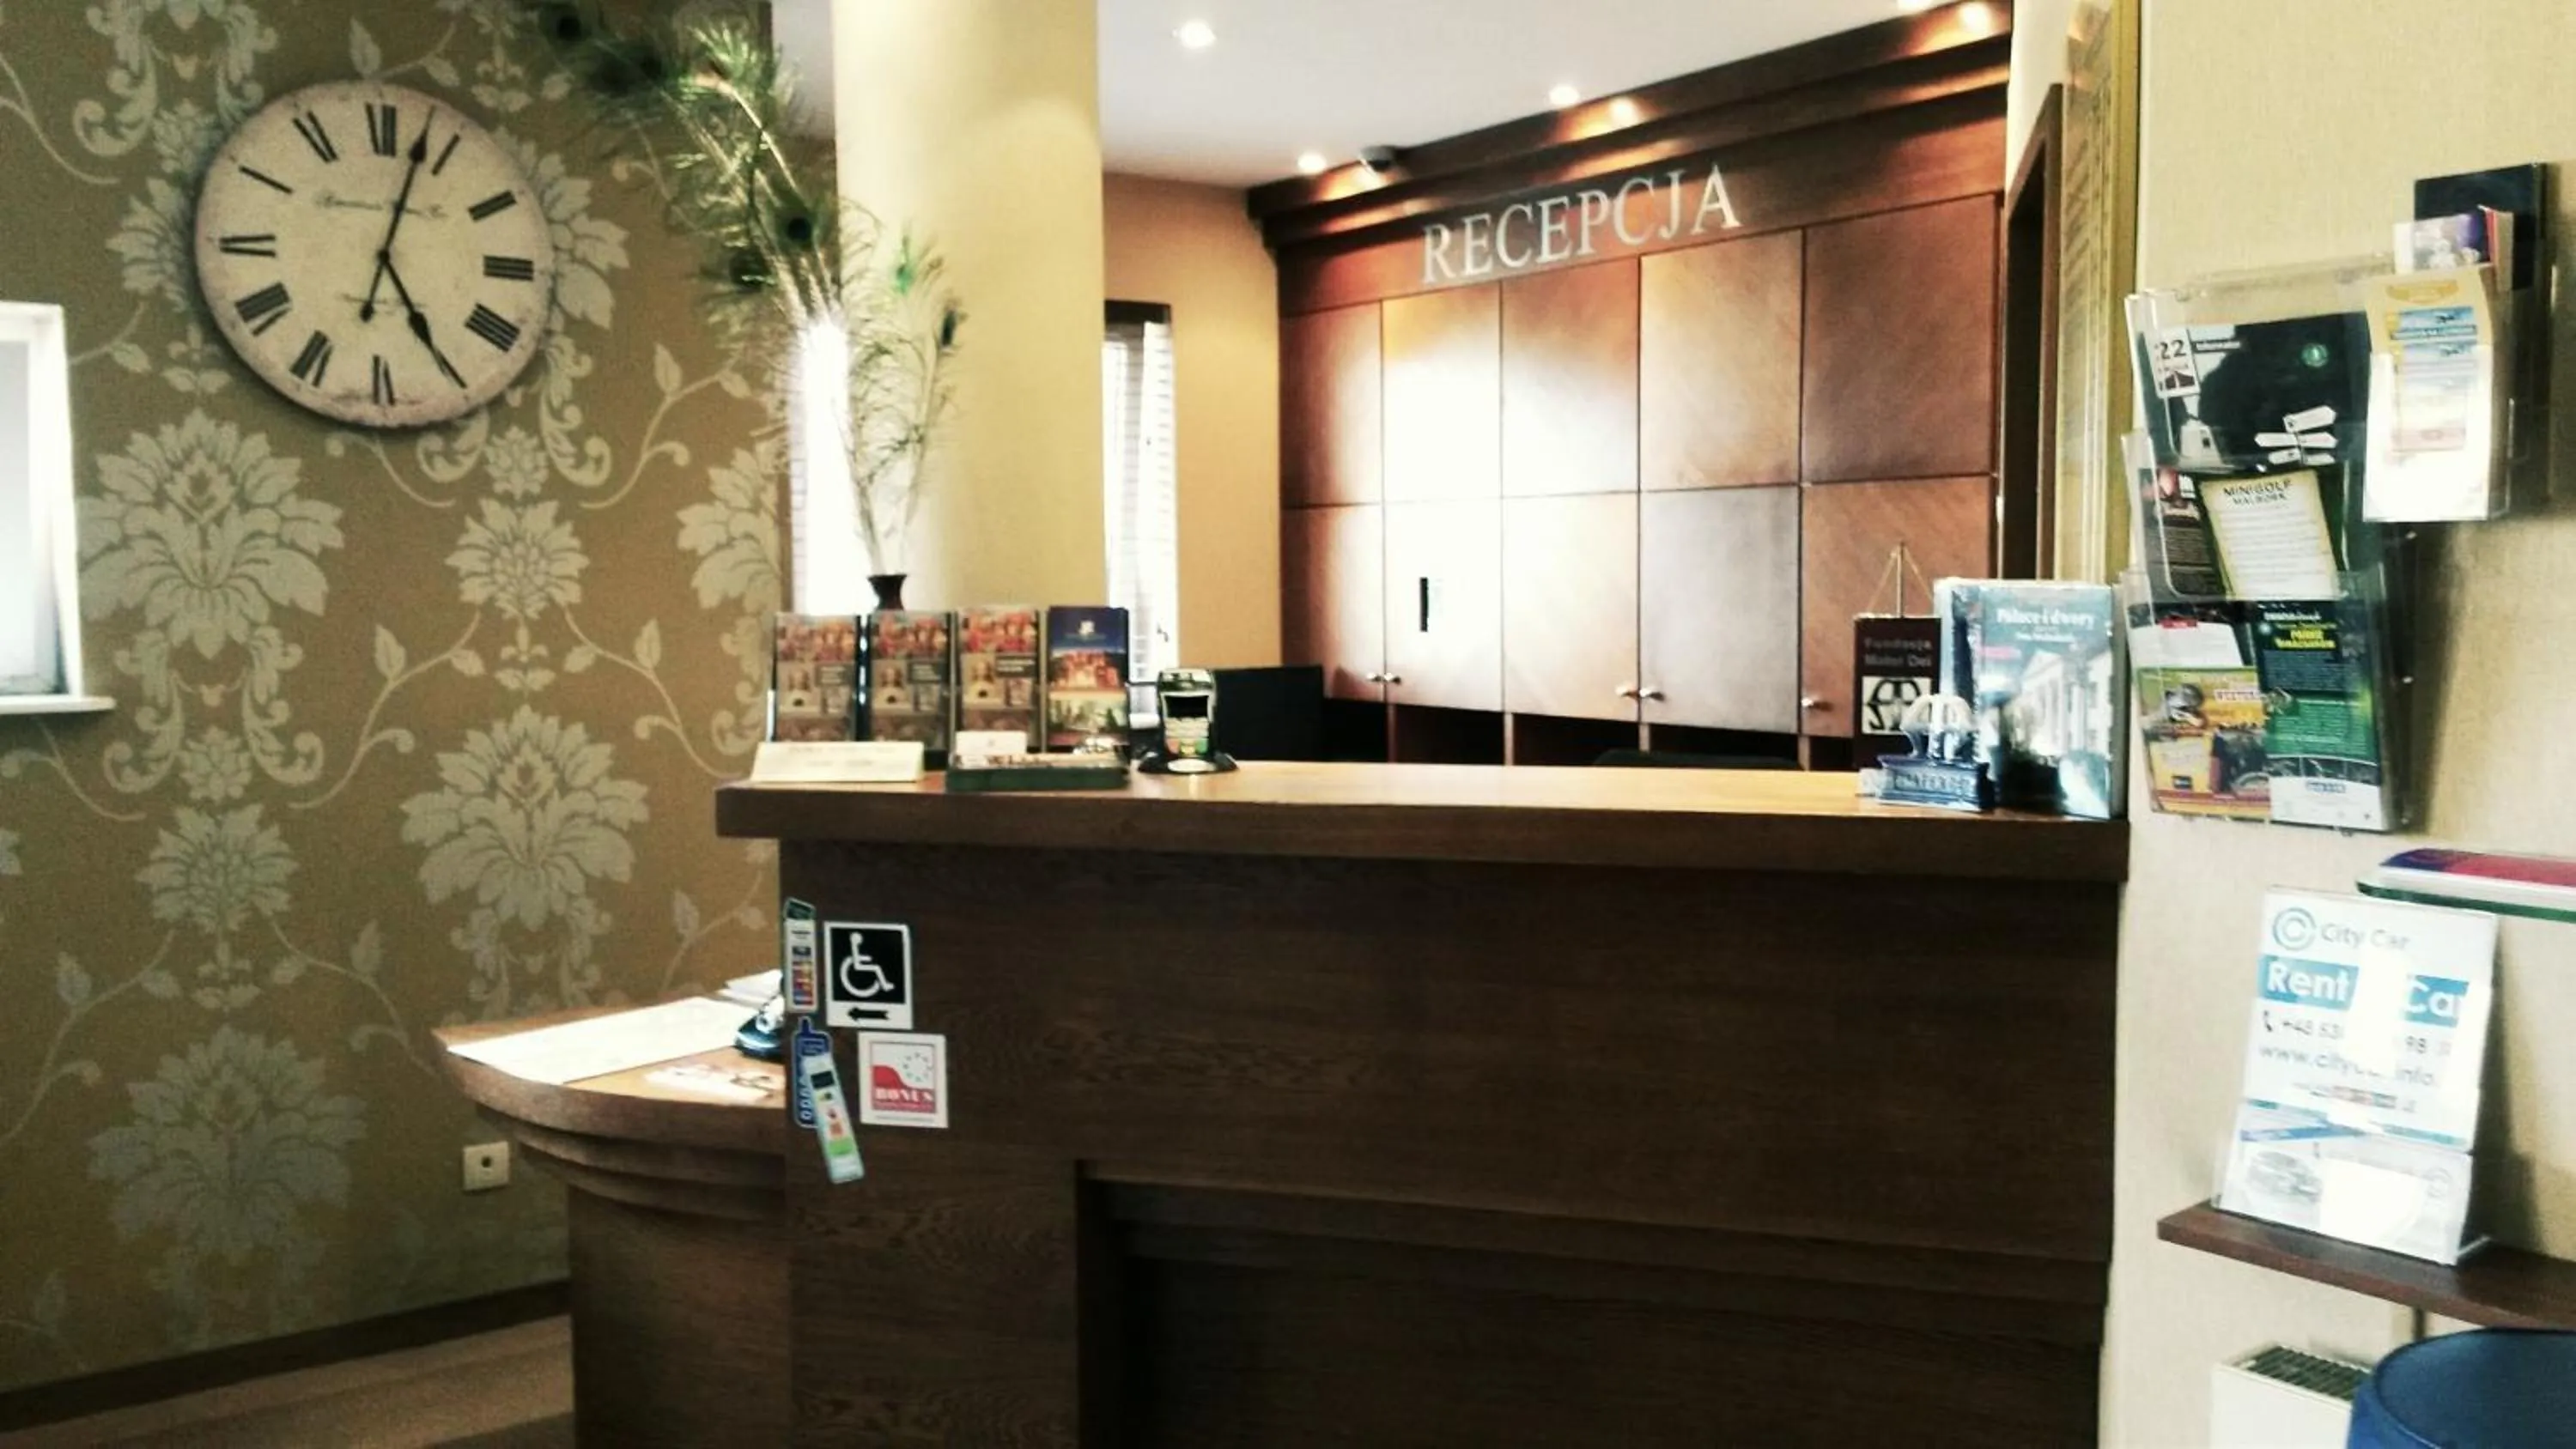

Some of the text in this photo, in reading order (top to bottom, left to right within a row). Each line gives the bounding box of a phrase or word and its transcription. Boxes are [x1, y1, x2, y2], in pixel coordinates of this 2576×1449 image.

[1422, 163, 1743, 286] RECEPCJA
[2321, 922, 2364, 949] City
[2266, 961, 2464, 1018] Rent Ca
